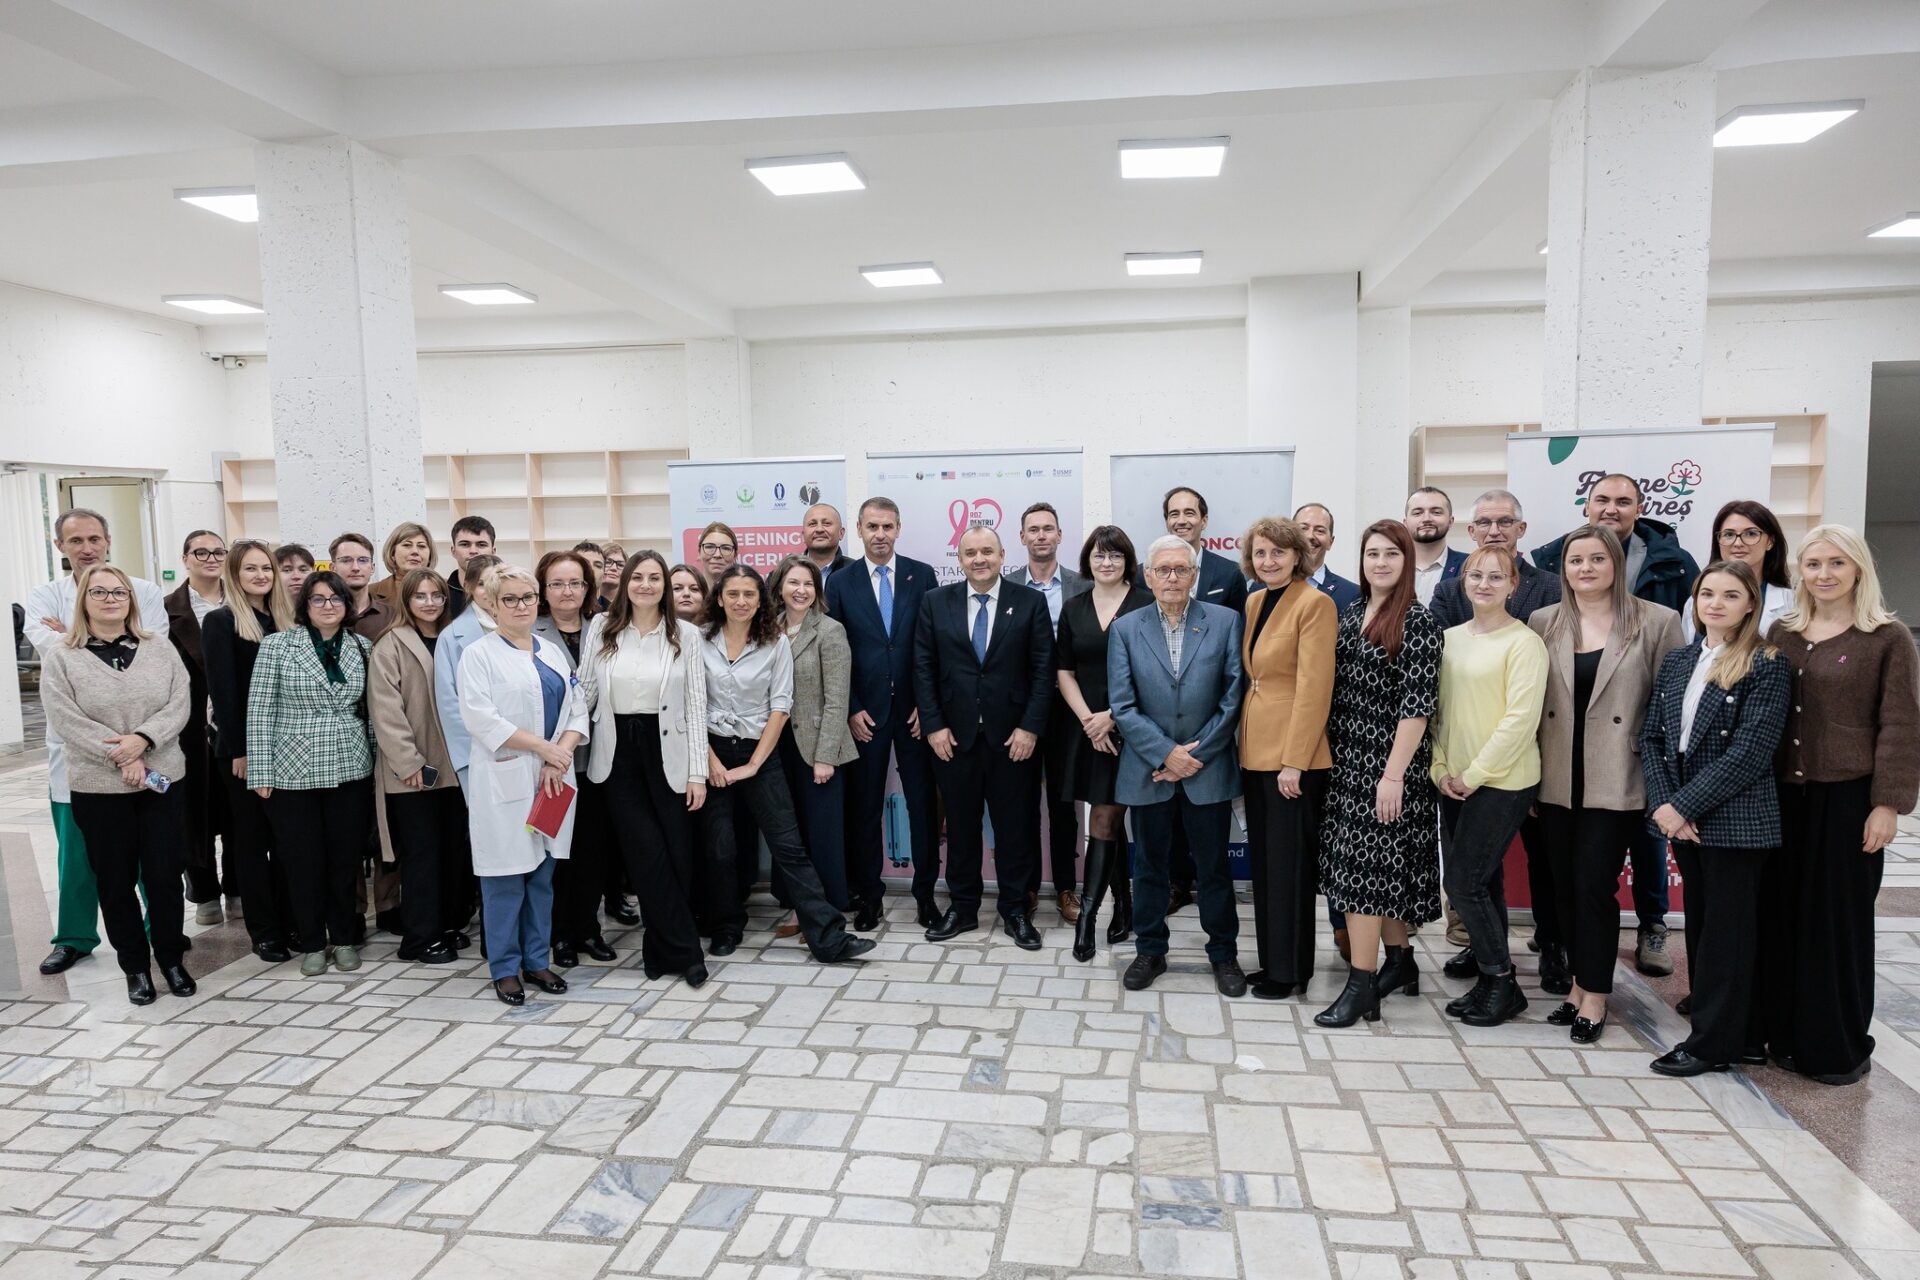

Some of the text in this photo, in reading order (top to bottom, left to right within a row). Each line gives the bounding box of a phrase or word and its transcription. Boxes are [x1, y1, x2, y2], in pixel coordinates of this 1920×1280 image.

[1575, 471, 1669, 495] Fre
[1636, 492, 1693, 521] ireș
[698, 532, 804, 546] EENING
